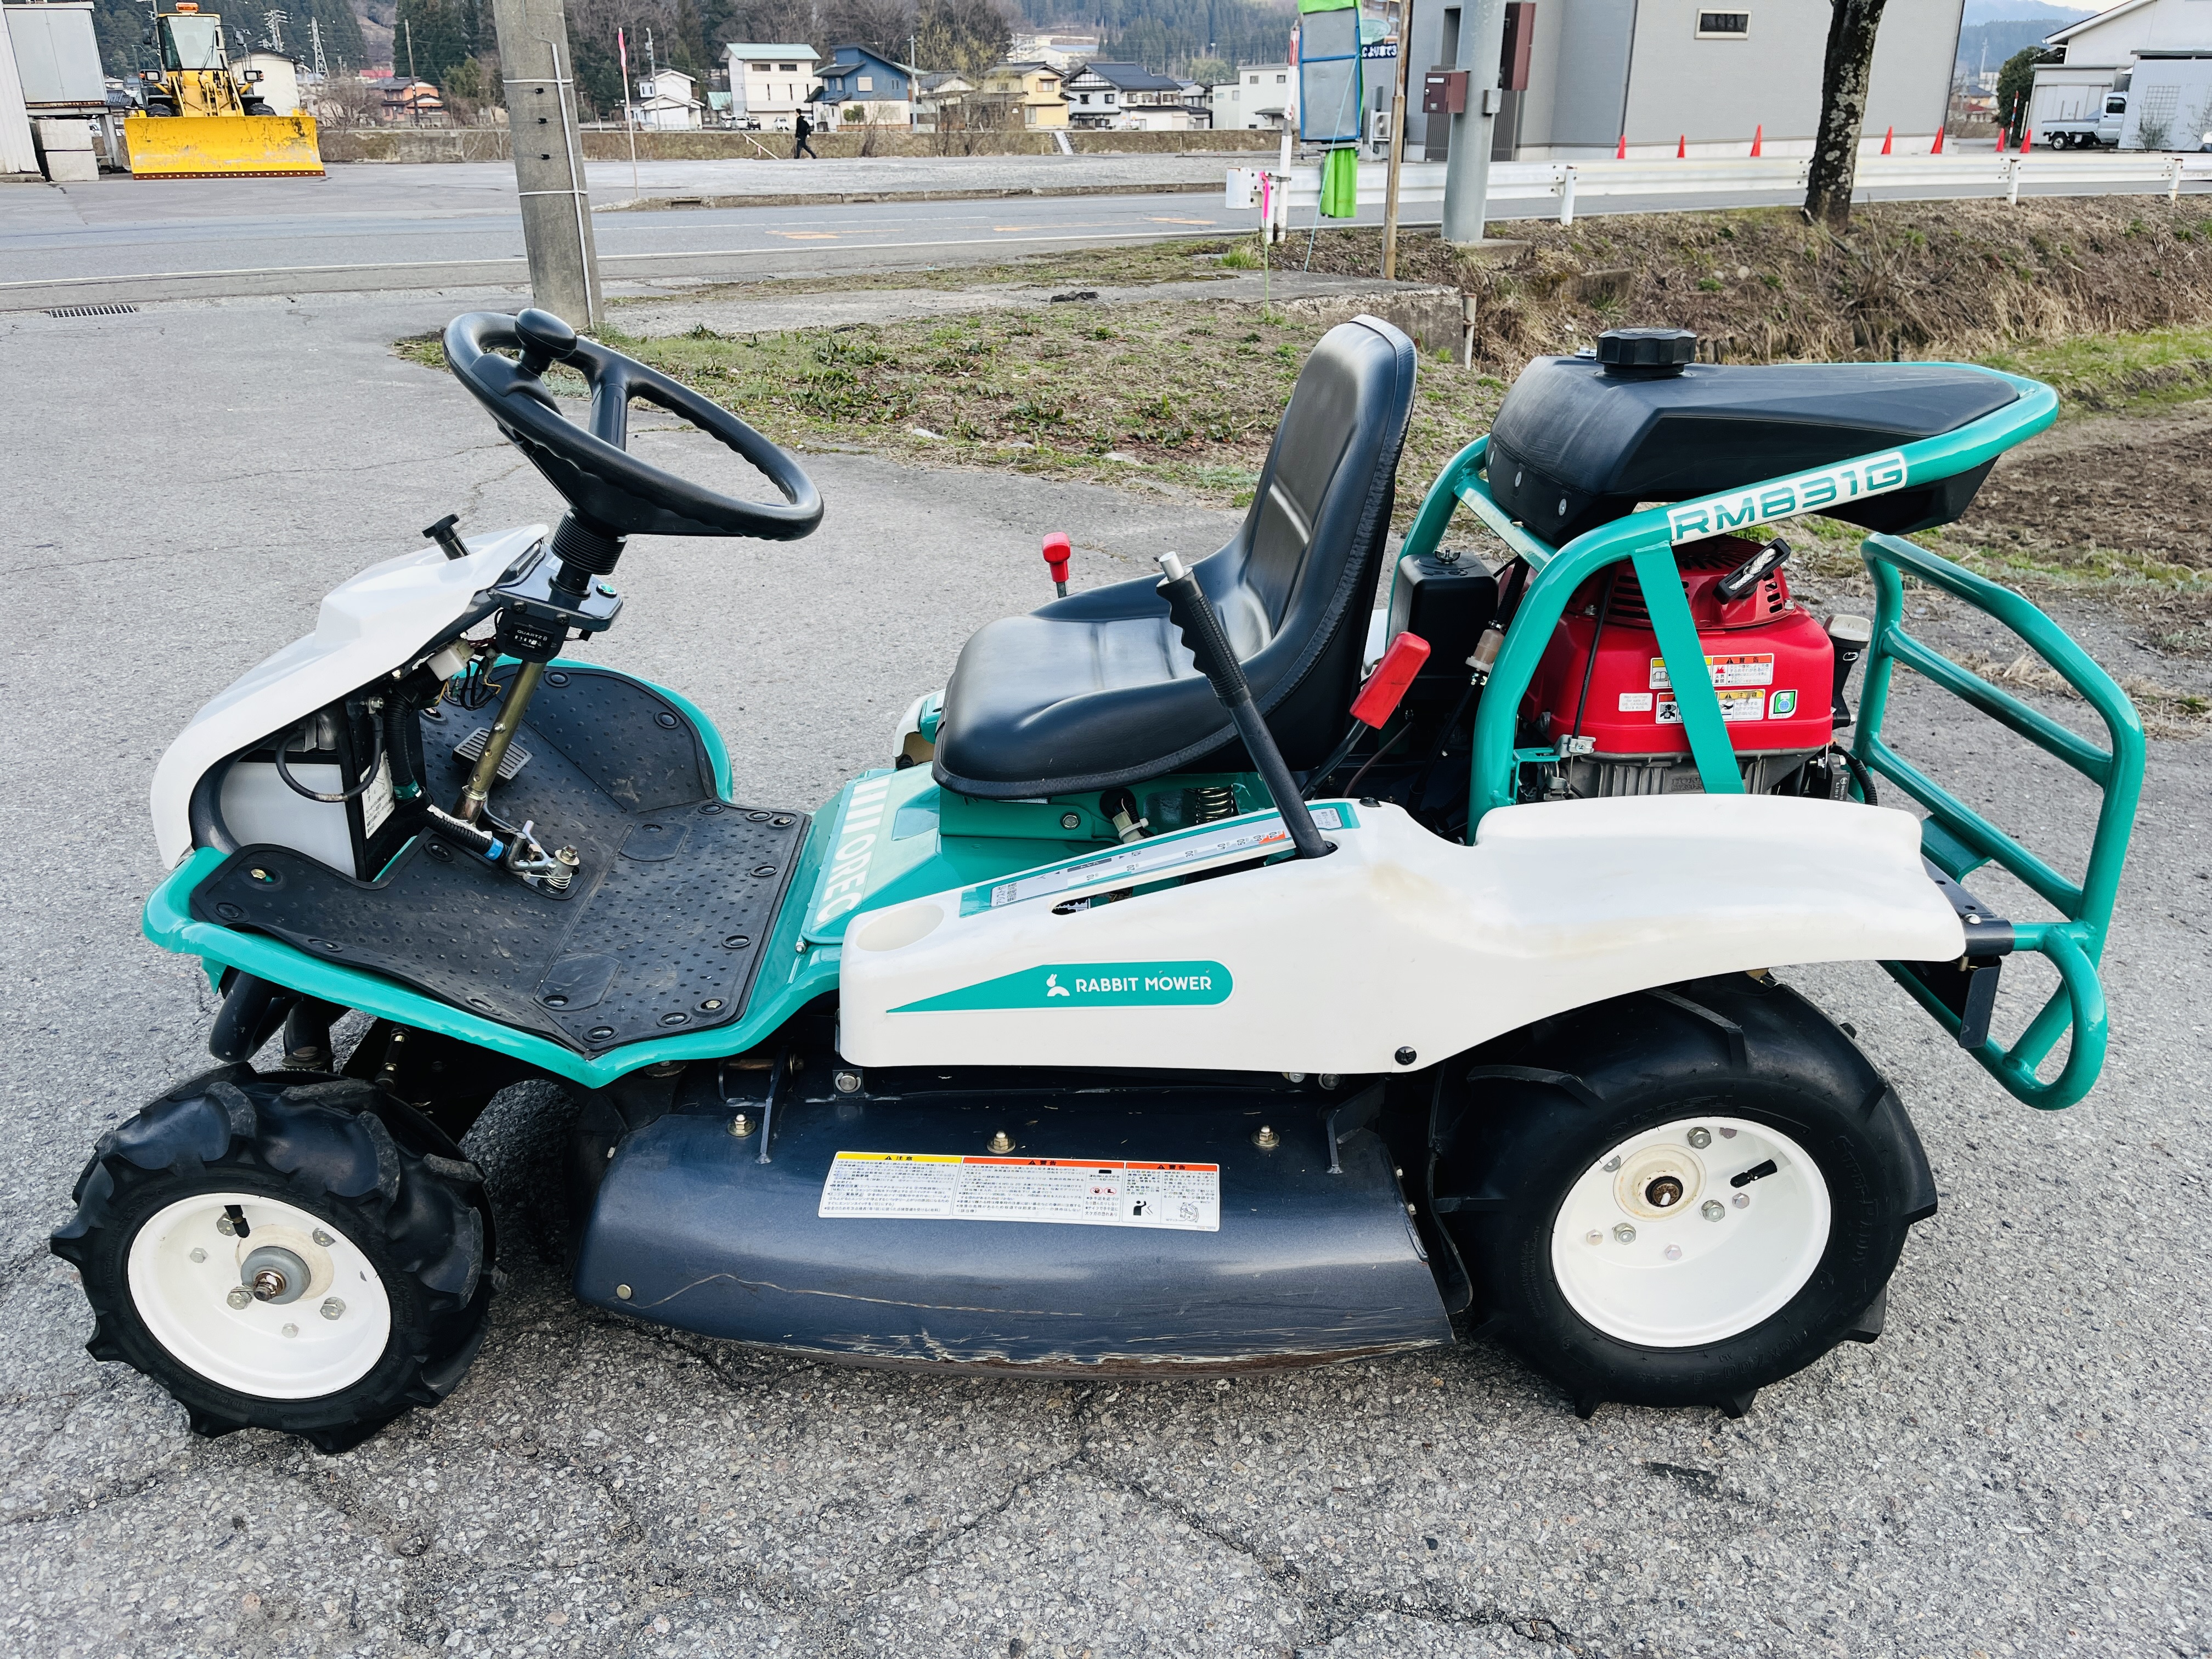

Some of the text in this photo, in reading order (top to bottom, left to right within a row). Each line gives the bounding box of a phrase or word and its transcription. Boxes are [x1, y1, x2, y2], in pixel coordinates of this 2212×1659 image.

[1673, 458, 1904, 541] RM831G
[517, 630, 543, 639] QUARTZ
[1185, 850, 1193, 858] 30
[817, 833, 877, 922] OREC
[1075, 974, 1212, 992] RABBIT MOWER
